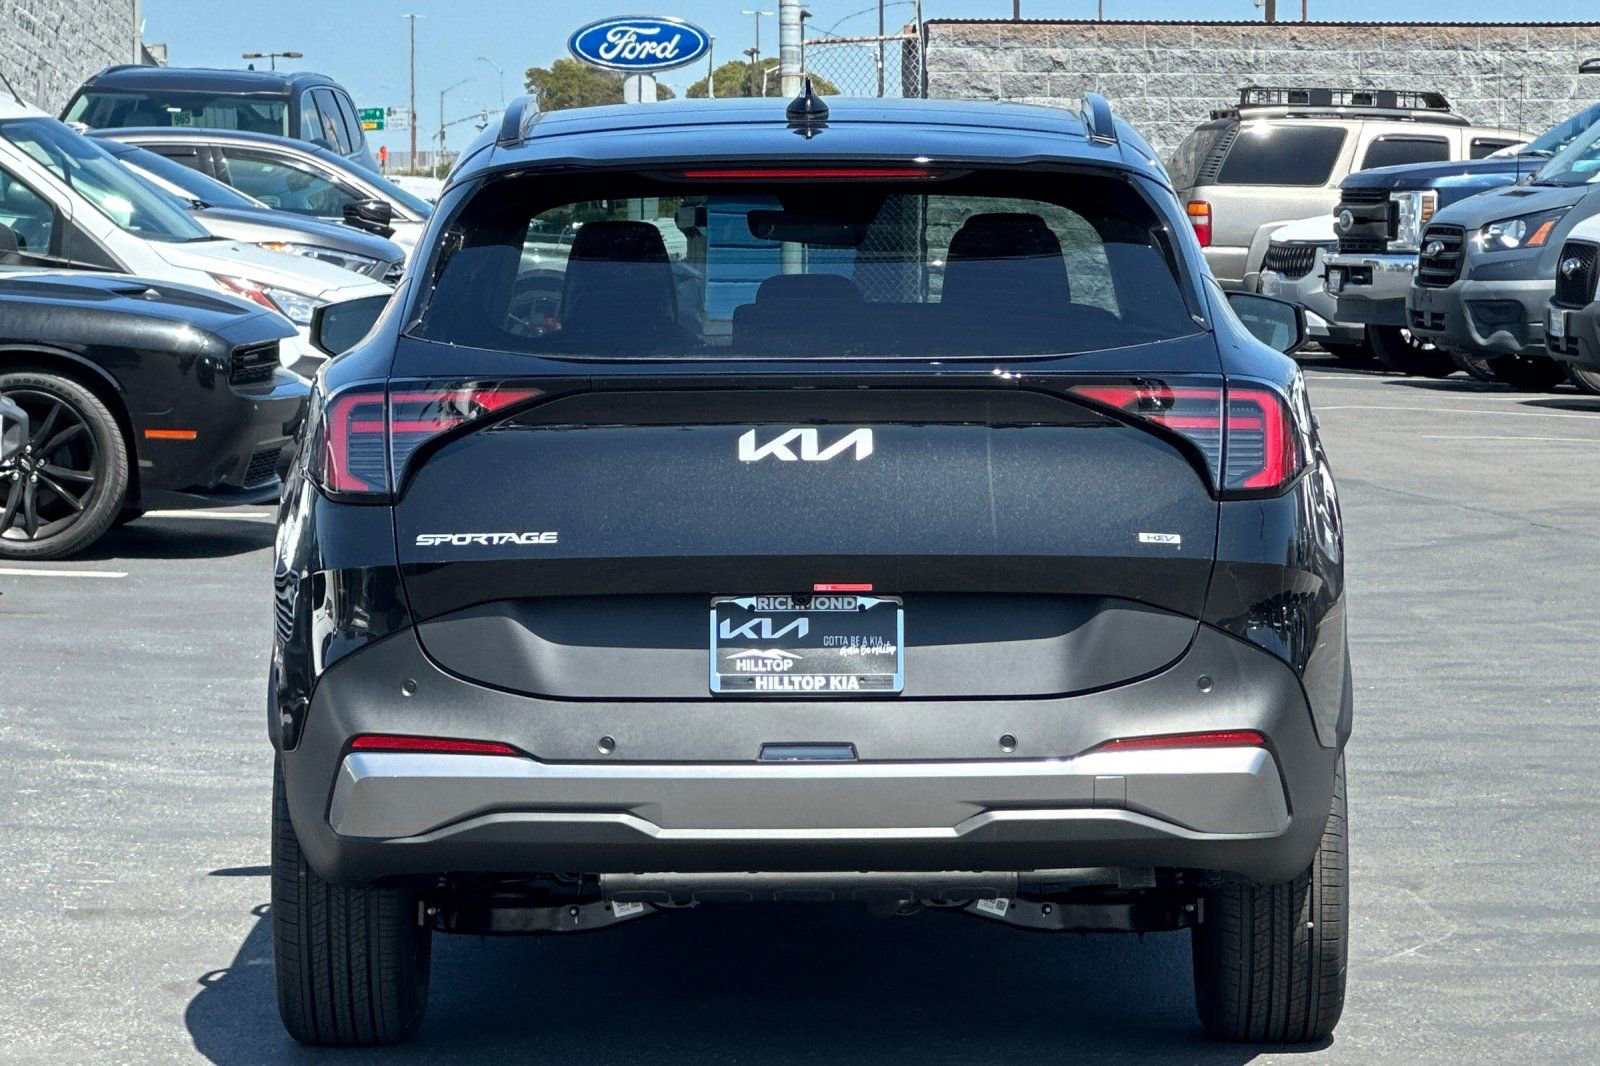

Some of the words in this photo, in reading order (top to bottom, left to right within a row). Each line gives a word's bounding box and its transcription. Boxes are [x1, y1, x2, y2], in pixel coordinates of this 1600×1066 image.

[599, 26, 681, 60] Ford
[738, 428, 873, 462] KIA
[415, 531, 559, 547] SPORTAGE
[719, 617, 809, 639] KIA
[823, 636, 849, 646] GOTTA
[850, 636, 860, 646] BE
[862, 636, 868, 646] A
[870, 636, 883, 646] KIA
[736, 659, 793, 671] HILLTOP
[755, 675, 827, 690] HILLTOP
[830, 675, 860, 690] KIA
